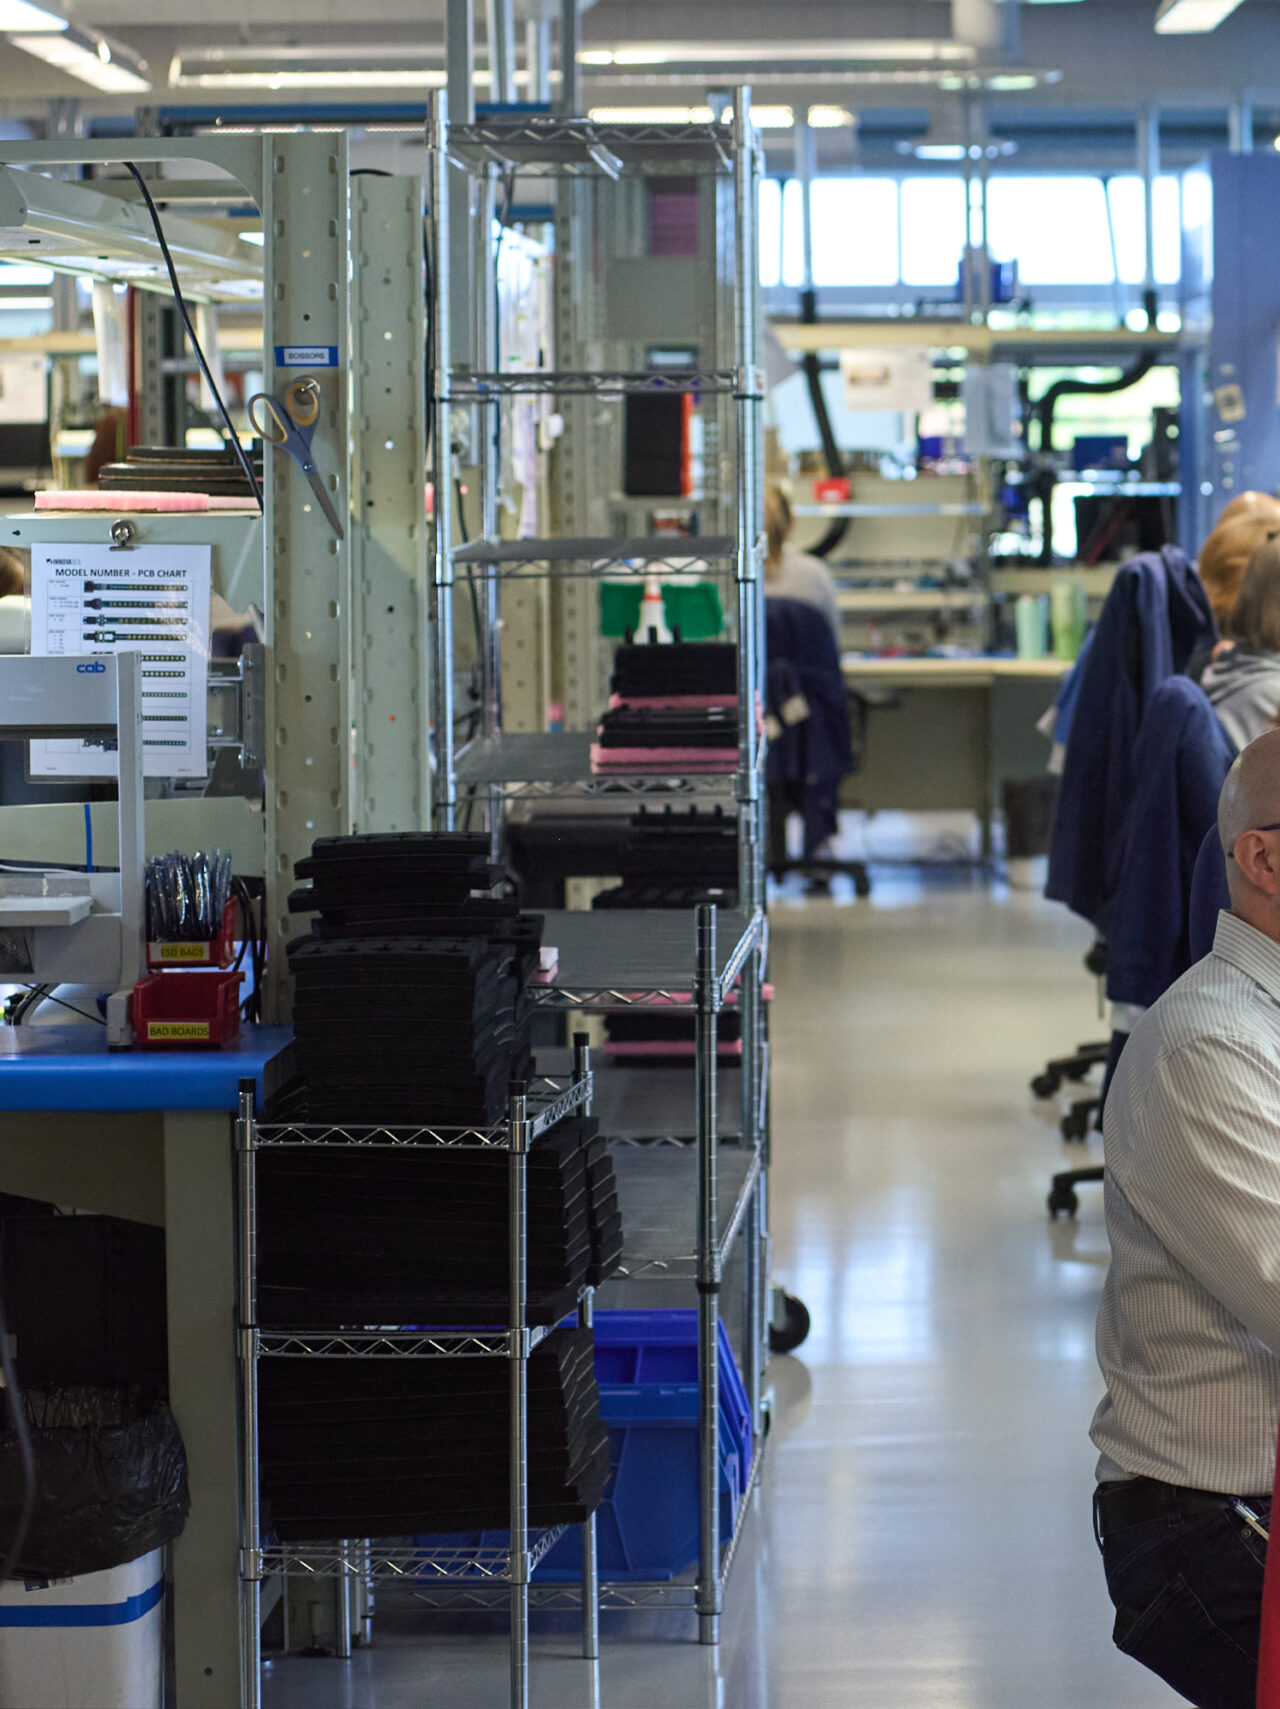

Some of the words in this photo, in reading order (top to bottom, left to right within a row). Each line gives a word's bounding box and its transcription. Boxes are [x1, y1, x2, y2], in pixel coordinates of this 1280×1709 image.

[288, 352, 325, 360] SCISSORS
[55, 568, 88, 577] MODEL
[90, 569, 130, 577] NUMBER
[138, 569, 155, 578] PCB
[157, 569, 187, 578] CHART
[76, 661, 106, 673] cab
[161, 948, 178, 957] ESD
[180, 948, 205, 957] BAGS
[149, 1027, 169, 1036] BAD
[171, 1027, 209, 1036] BOARDS
